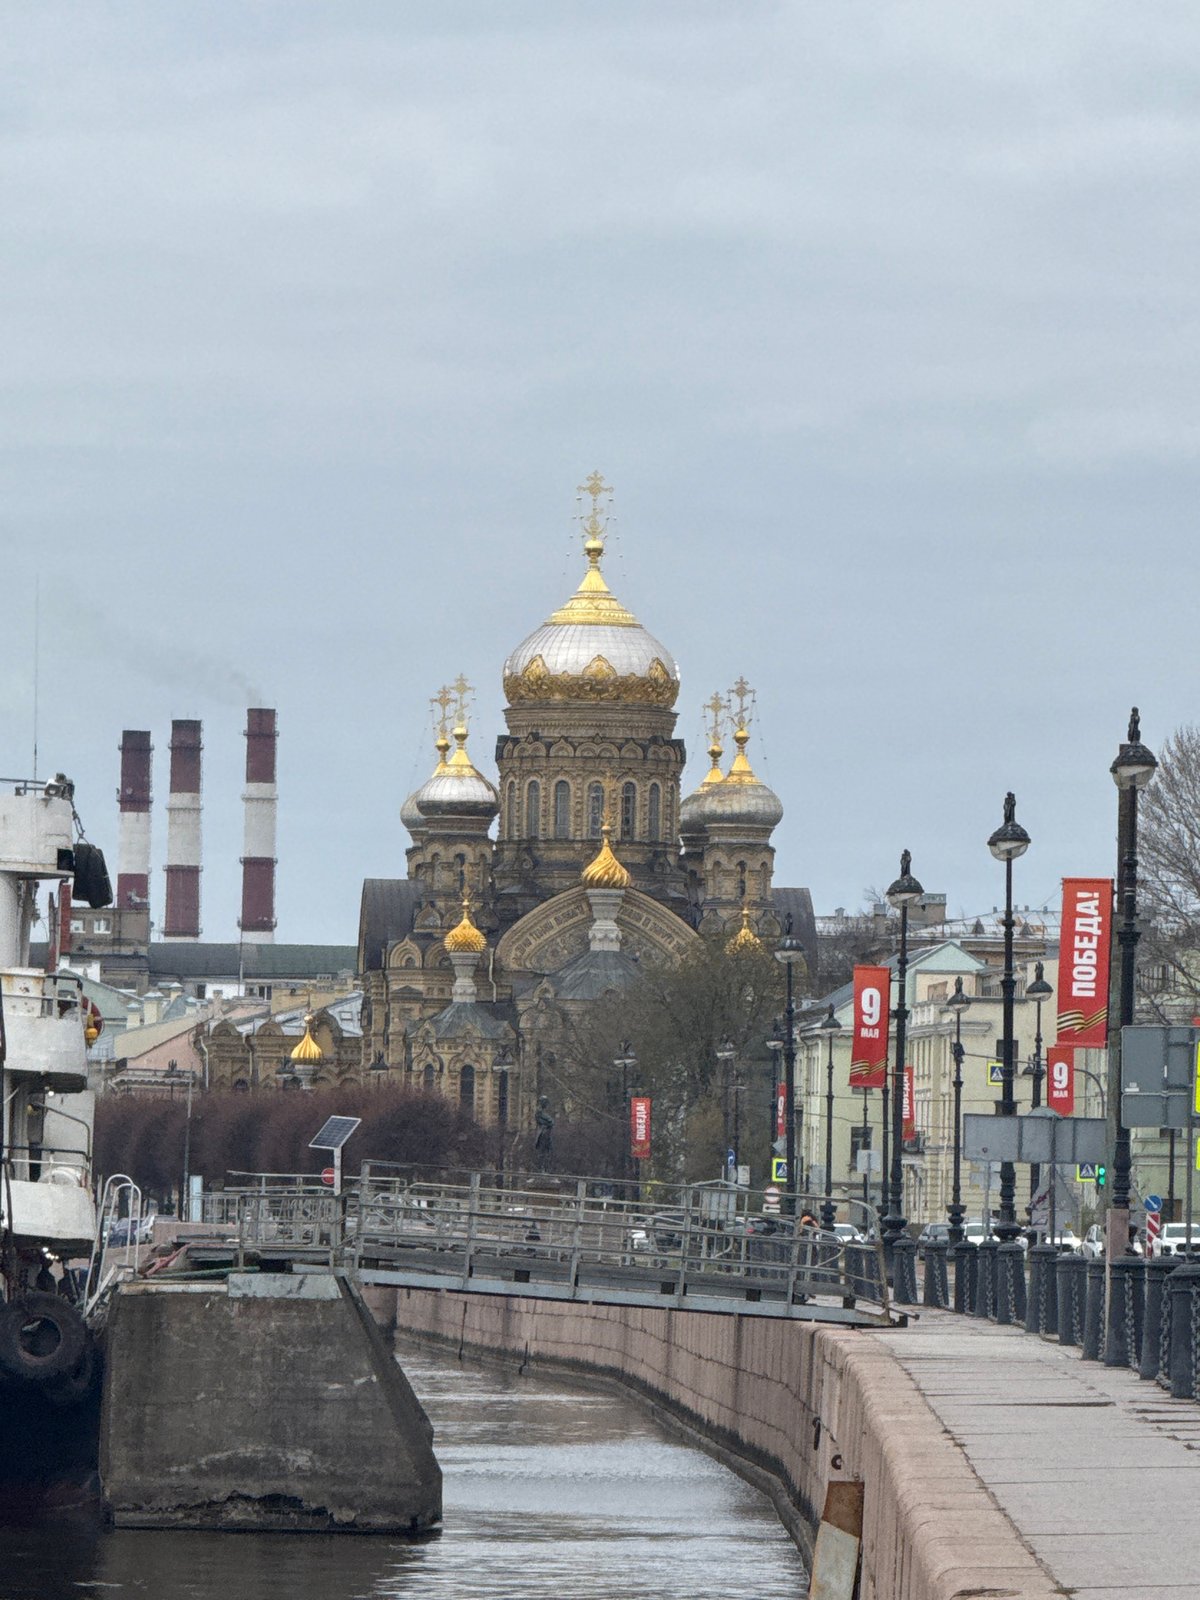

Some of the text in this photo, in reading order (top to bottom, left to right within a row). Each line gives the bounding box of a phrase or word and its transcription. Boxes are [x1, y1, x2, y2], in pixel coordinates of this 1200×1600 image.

[1072, 891, 1103, 997] ПОБЕДА!
[861, 987, 881, 1026] 9
[860, 1027, 880, 1039] МАЯ
[1053, 1062, 1069, 1089] 9
[636, 1102, 647, 1140] ПОБЕДА!
